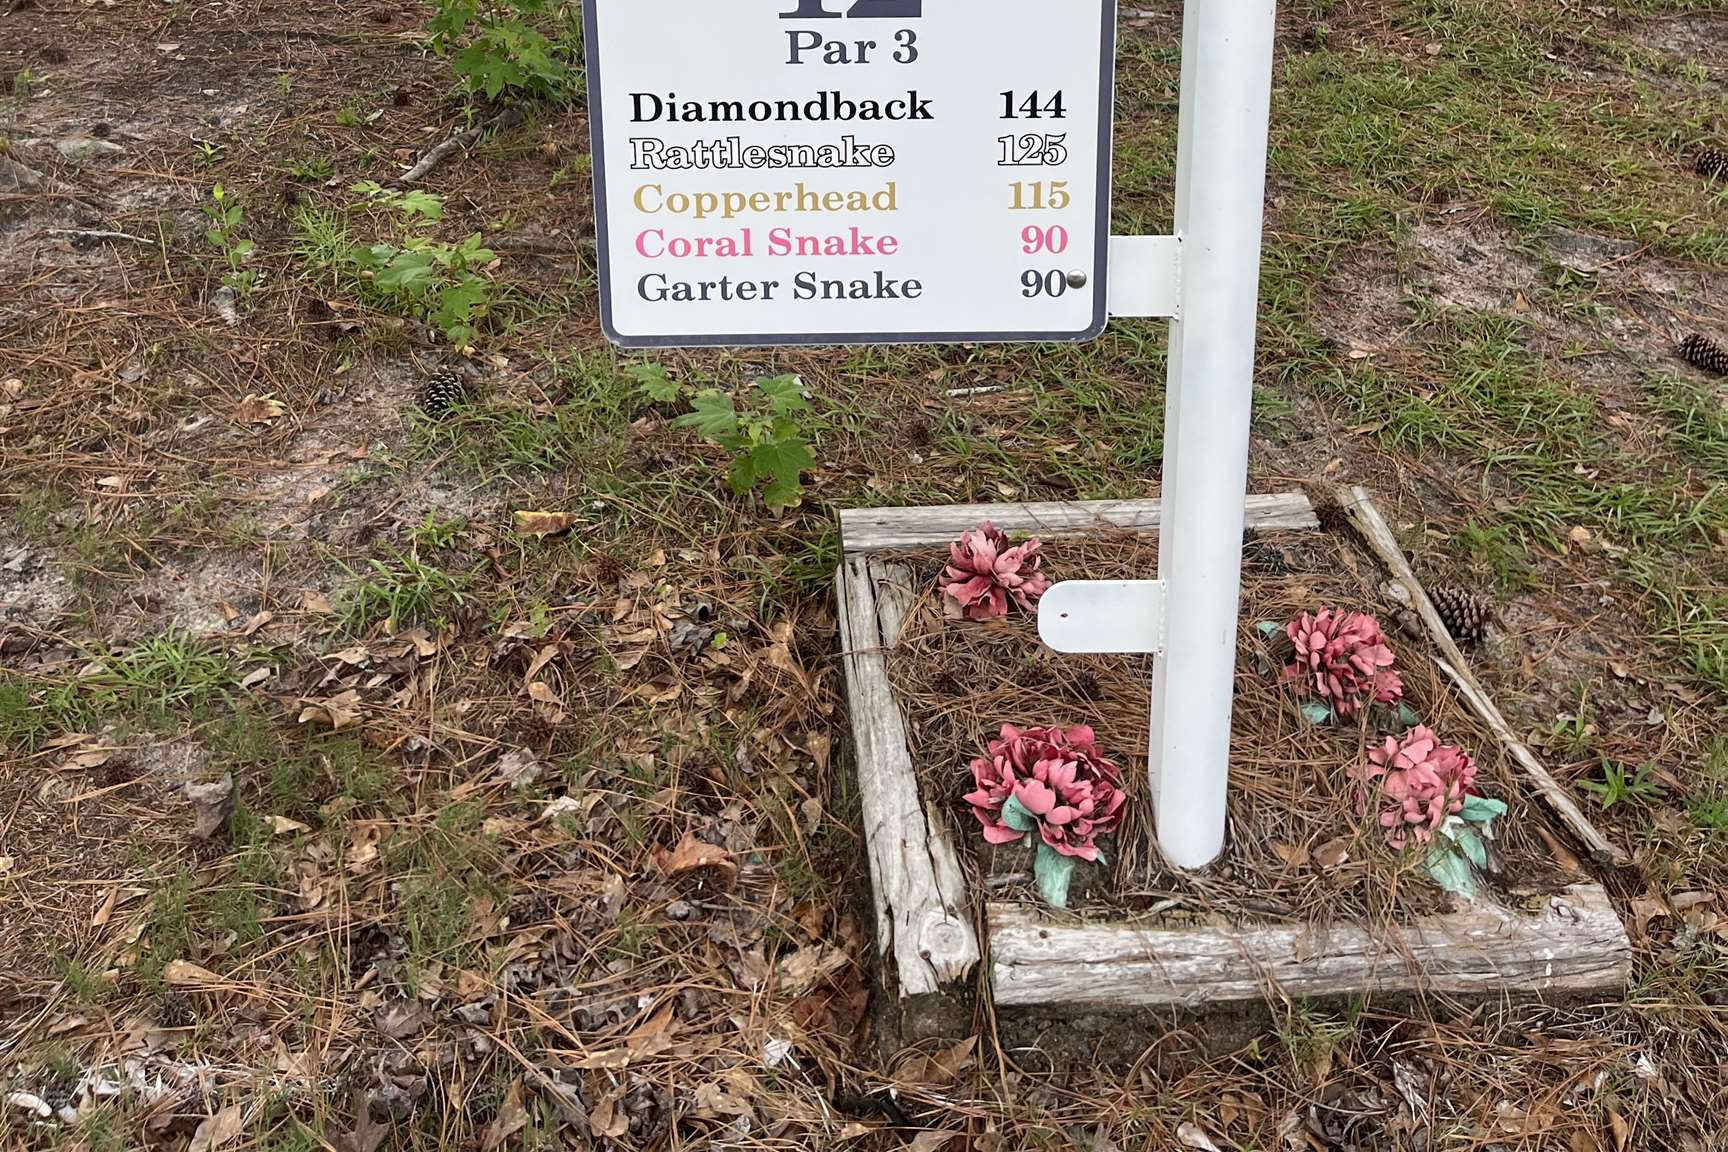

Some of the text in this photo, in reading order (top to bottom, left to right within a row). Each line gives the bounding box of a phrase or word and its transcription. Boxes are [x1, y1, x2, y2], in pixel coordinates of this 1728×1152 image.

[785, 29, 919, 64] Par 3
[628, 90, 1067, 122] Diamondback 144
[629, 132, 1068, 170] Rattlesnake 125
[633, 181, 1070, 219] Copperhead 115
[635, 224, 1068, 258] Coral Snake 90
[637, 269, 1067, 302] Garter Snake 90
